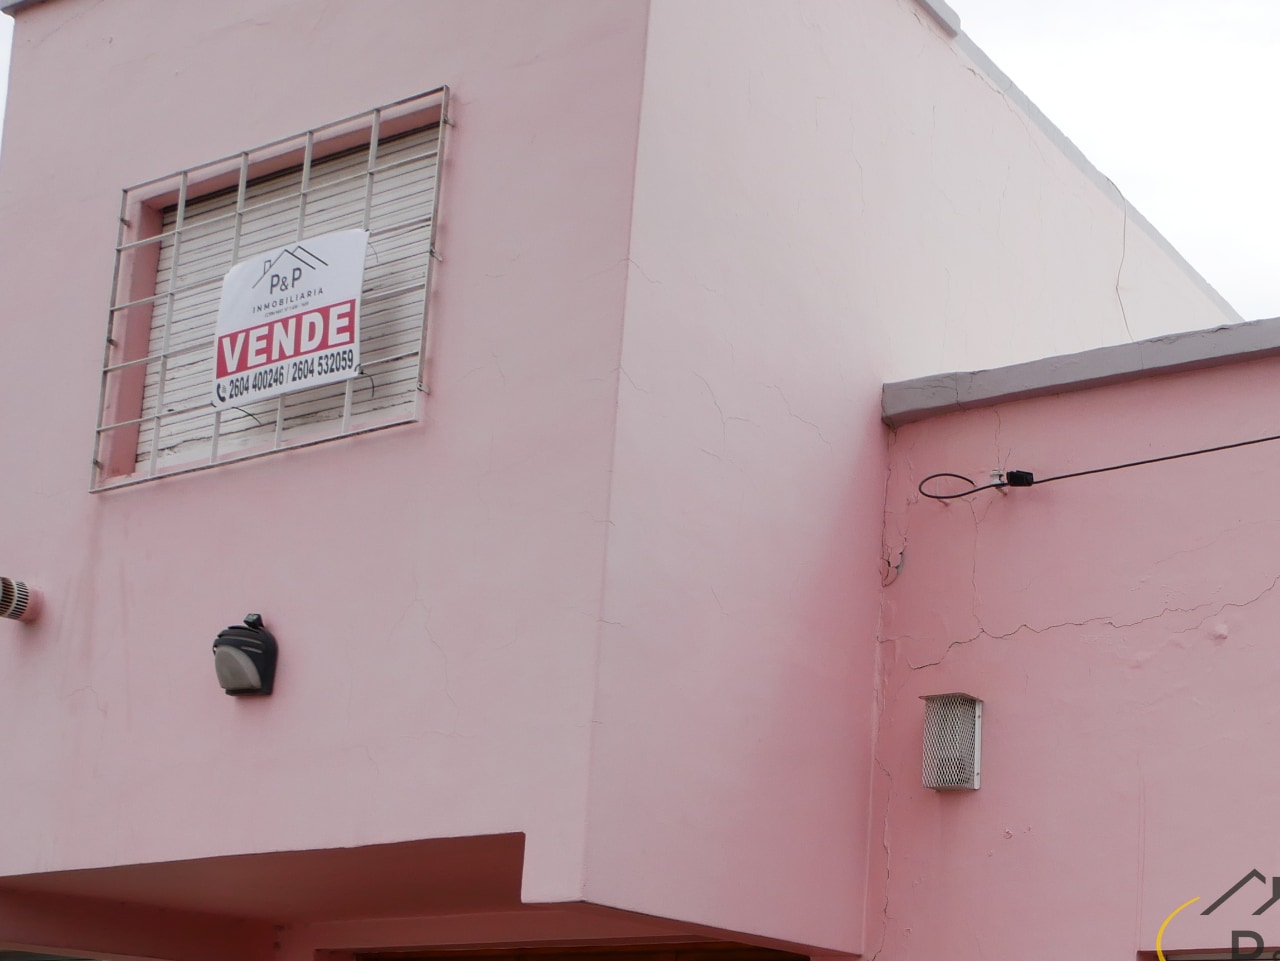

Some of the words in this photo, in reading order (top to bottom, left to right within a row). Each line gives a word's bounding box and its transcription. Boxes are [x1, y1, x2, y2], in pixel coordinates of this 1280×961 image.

[252, 287, 324, 314] INMOBILIARIA
[269, 267, 303, 295] P&P
[221, 303, 352, 373] VENDE
[229, 377, 250, 399] 2604
[252, 365, 284, 392] 400246
[291, 362, 315, 382] 2604
[317, 349, 354, 376] 532059
